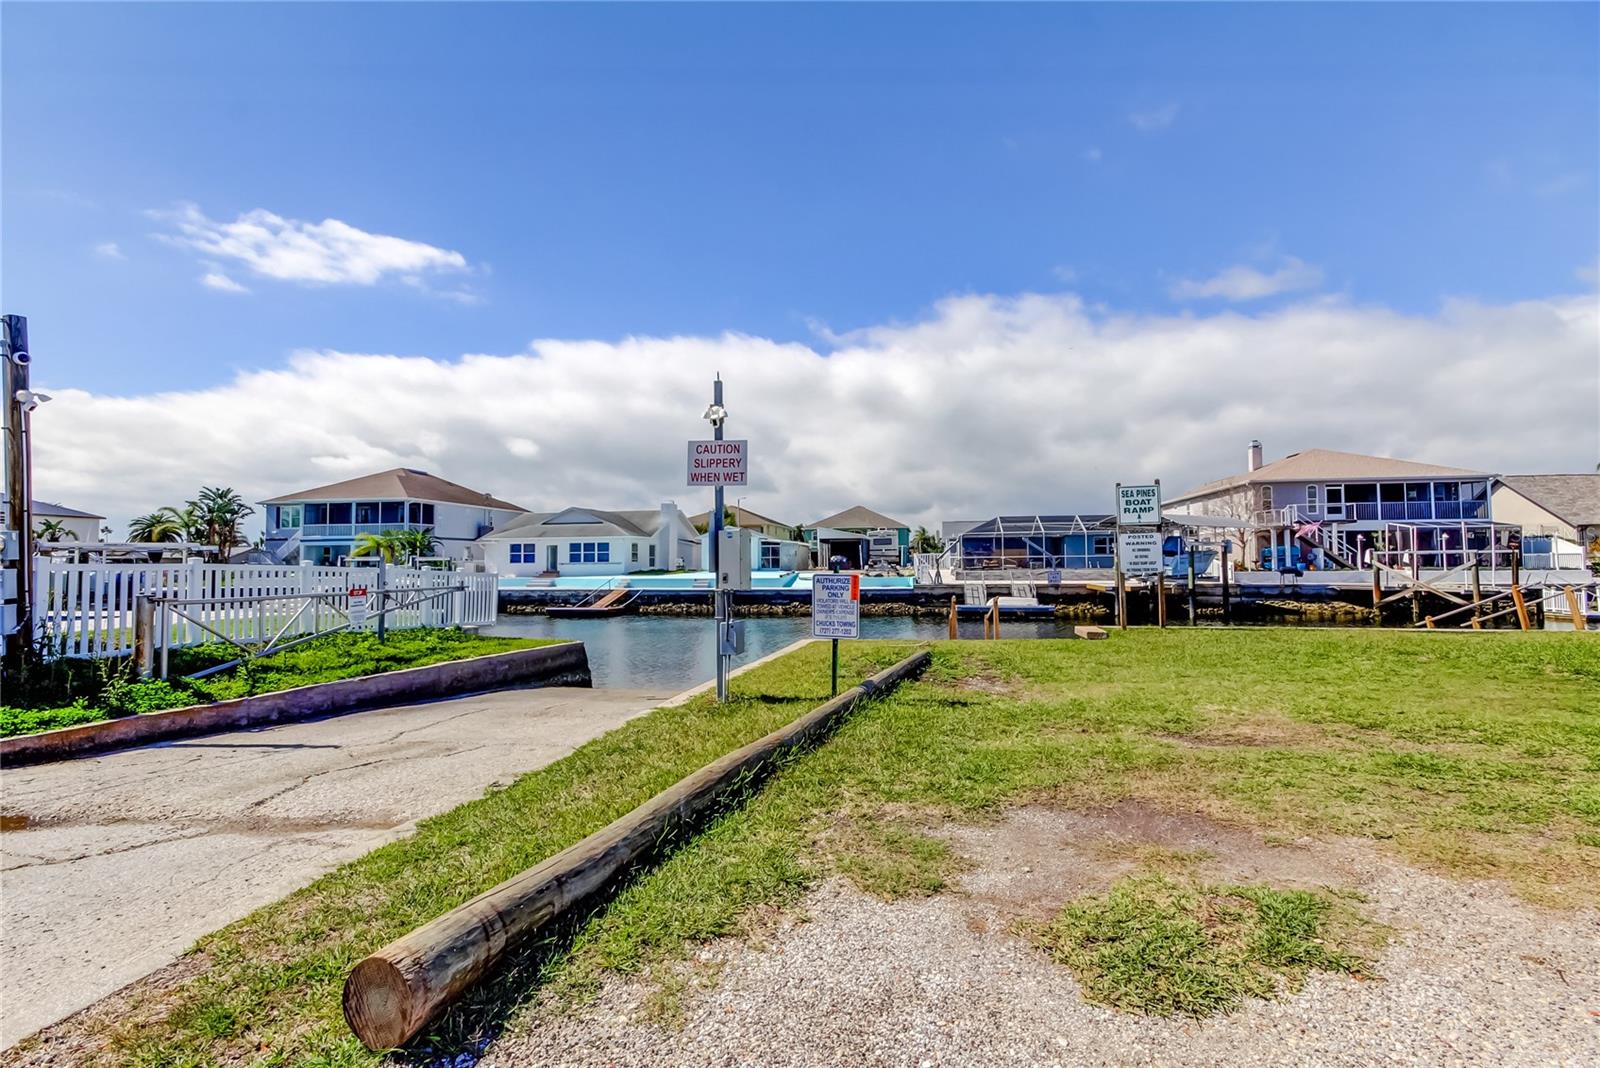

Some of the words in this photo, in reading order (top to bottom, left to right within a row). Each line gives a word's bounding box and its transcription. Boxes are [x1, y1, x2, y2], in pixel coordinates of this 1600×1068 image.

[695, 444, 740, 454] CAUTION
[694, 458, 742, 468] SLIPPERY
[690, 472, 720, 482] WHEN
[723, 472, 745, 482] WET
[1121, 490, 1134, 498] SEA
[1136, 489, 1156, 497] PINES
